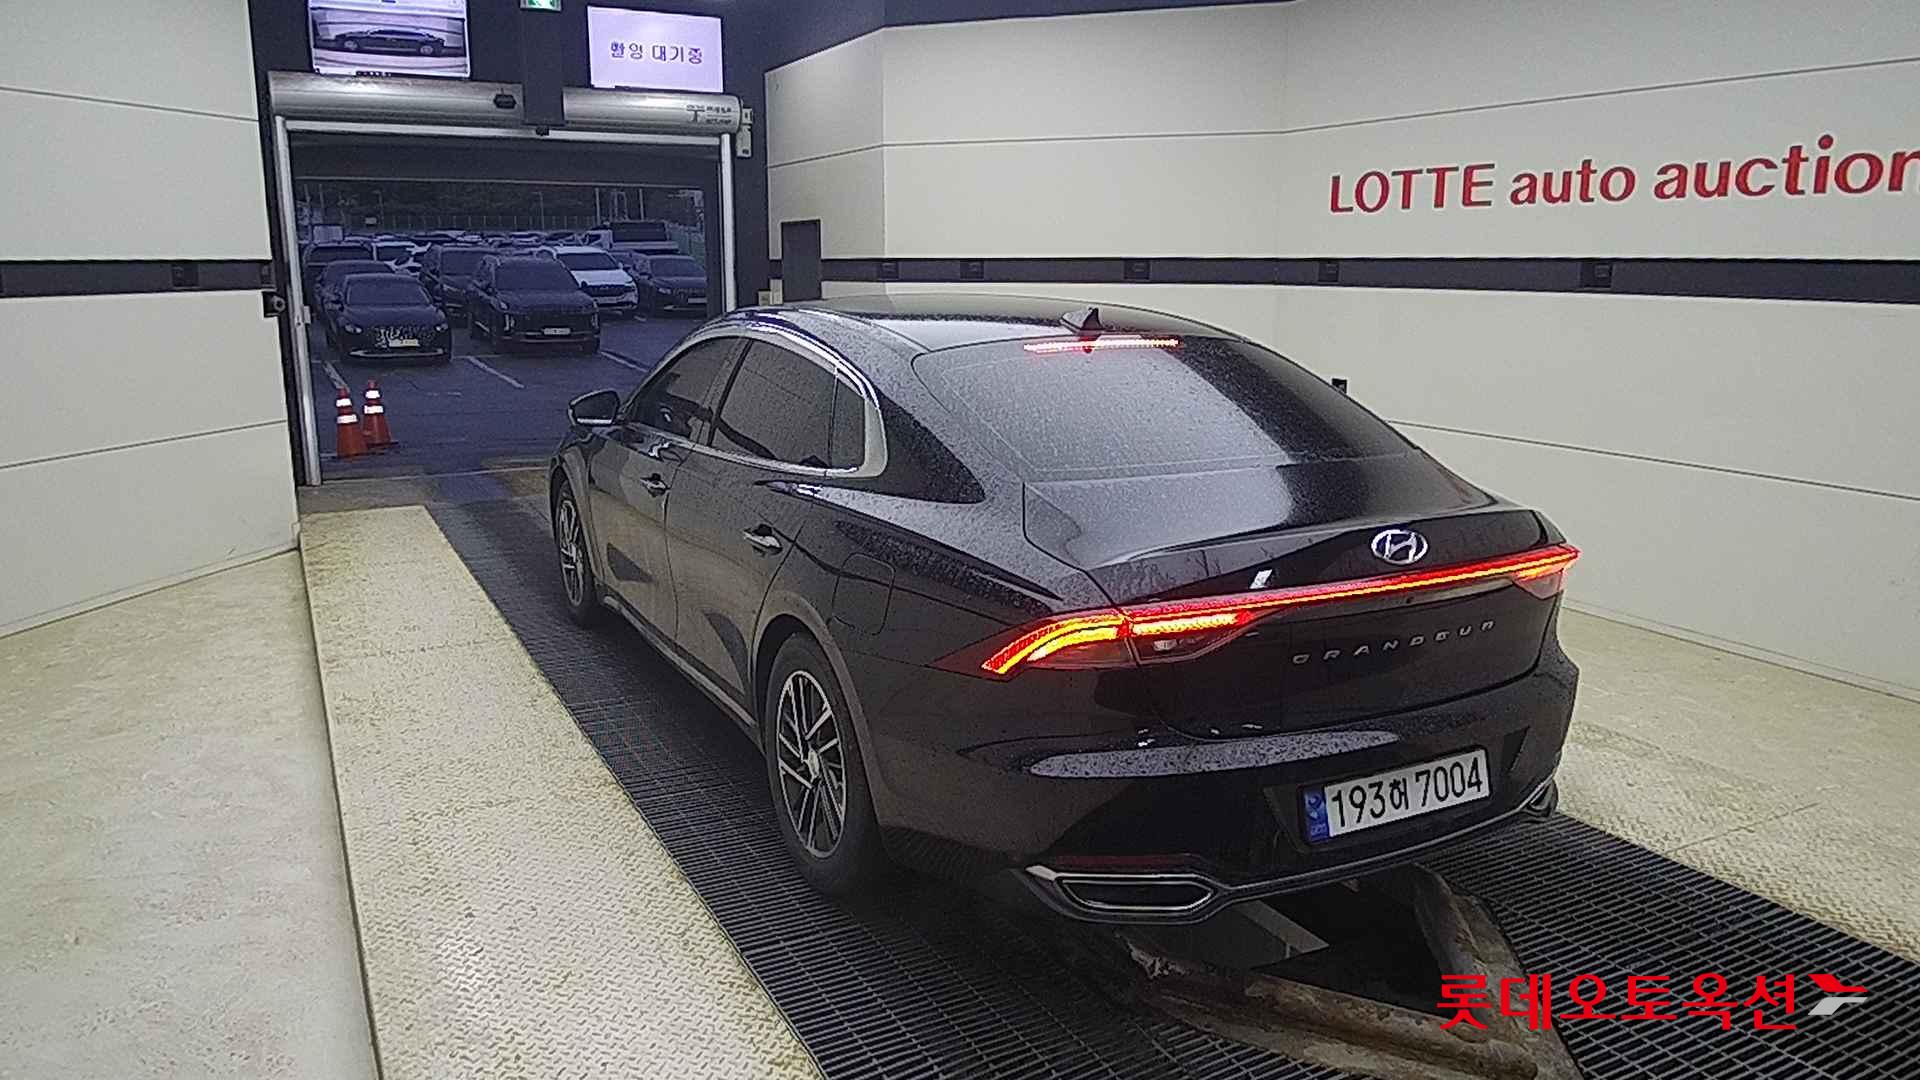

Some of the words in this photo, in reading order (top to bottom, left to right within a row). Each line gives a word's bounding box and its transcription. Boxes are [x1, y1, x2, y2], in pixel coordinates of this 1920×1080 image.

[652, 45, 703, 64] 대기중
[1330, 162, 1495, 213] LOTTE
[1510, 159, 1636, 205] auto
[1415, 757, 1483, 807] 7004
